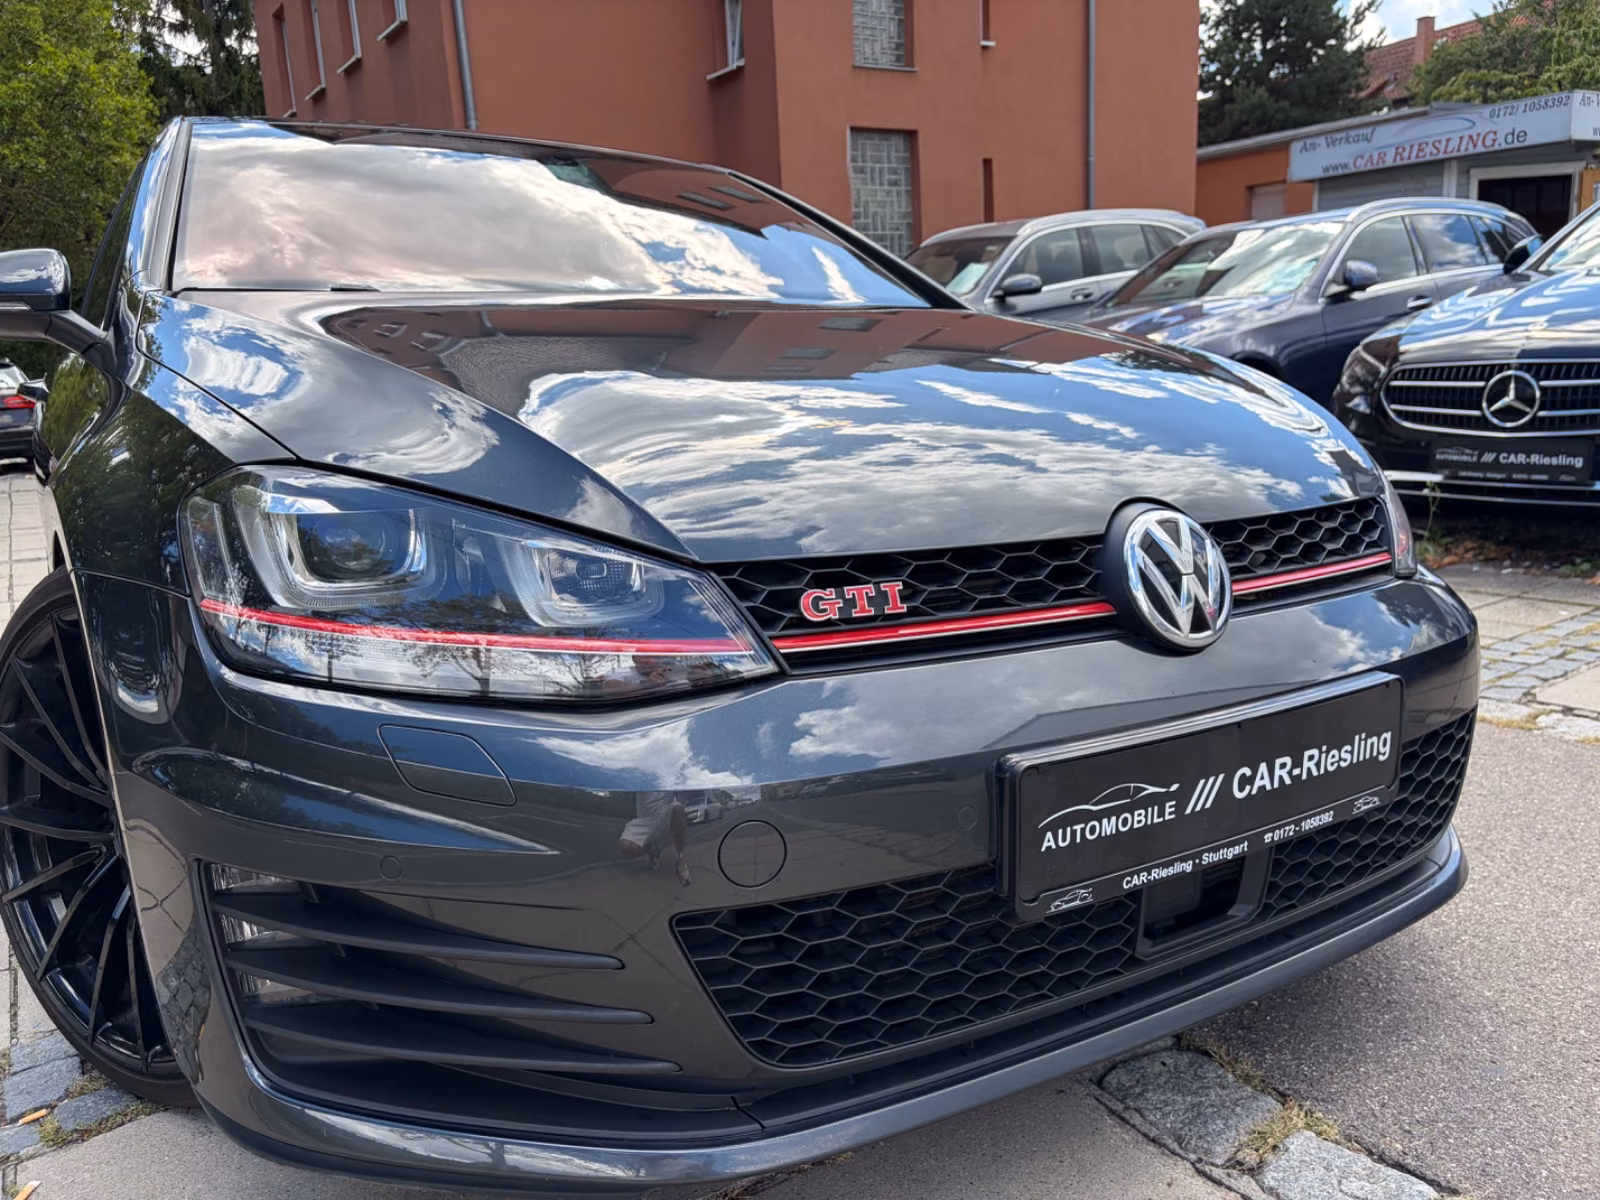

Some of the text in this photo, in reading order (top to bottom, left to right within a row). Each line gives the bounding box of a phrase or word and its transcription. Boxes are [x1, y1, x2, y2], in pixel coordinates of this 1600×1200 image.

[1522, 94, 1571, 114] 1058392
[1324, 127, 1377, 149] Verkauf
[1393, 127, 1528, 163] RIESLING.de
[1499, 452, 1583, 468] CAR-Riesling
[800, 582, 907, 622] GTI
[1041, 731, 1392, 852] AUTOMOBILE CAR-Riesling
[1123, 860, 1193, 889] CAR-Riesling
[1201, 840, 1249, 865] Stuttgart
